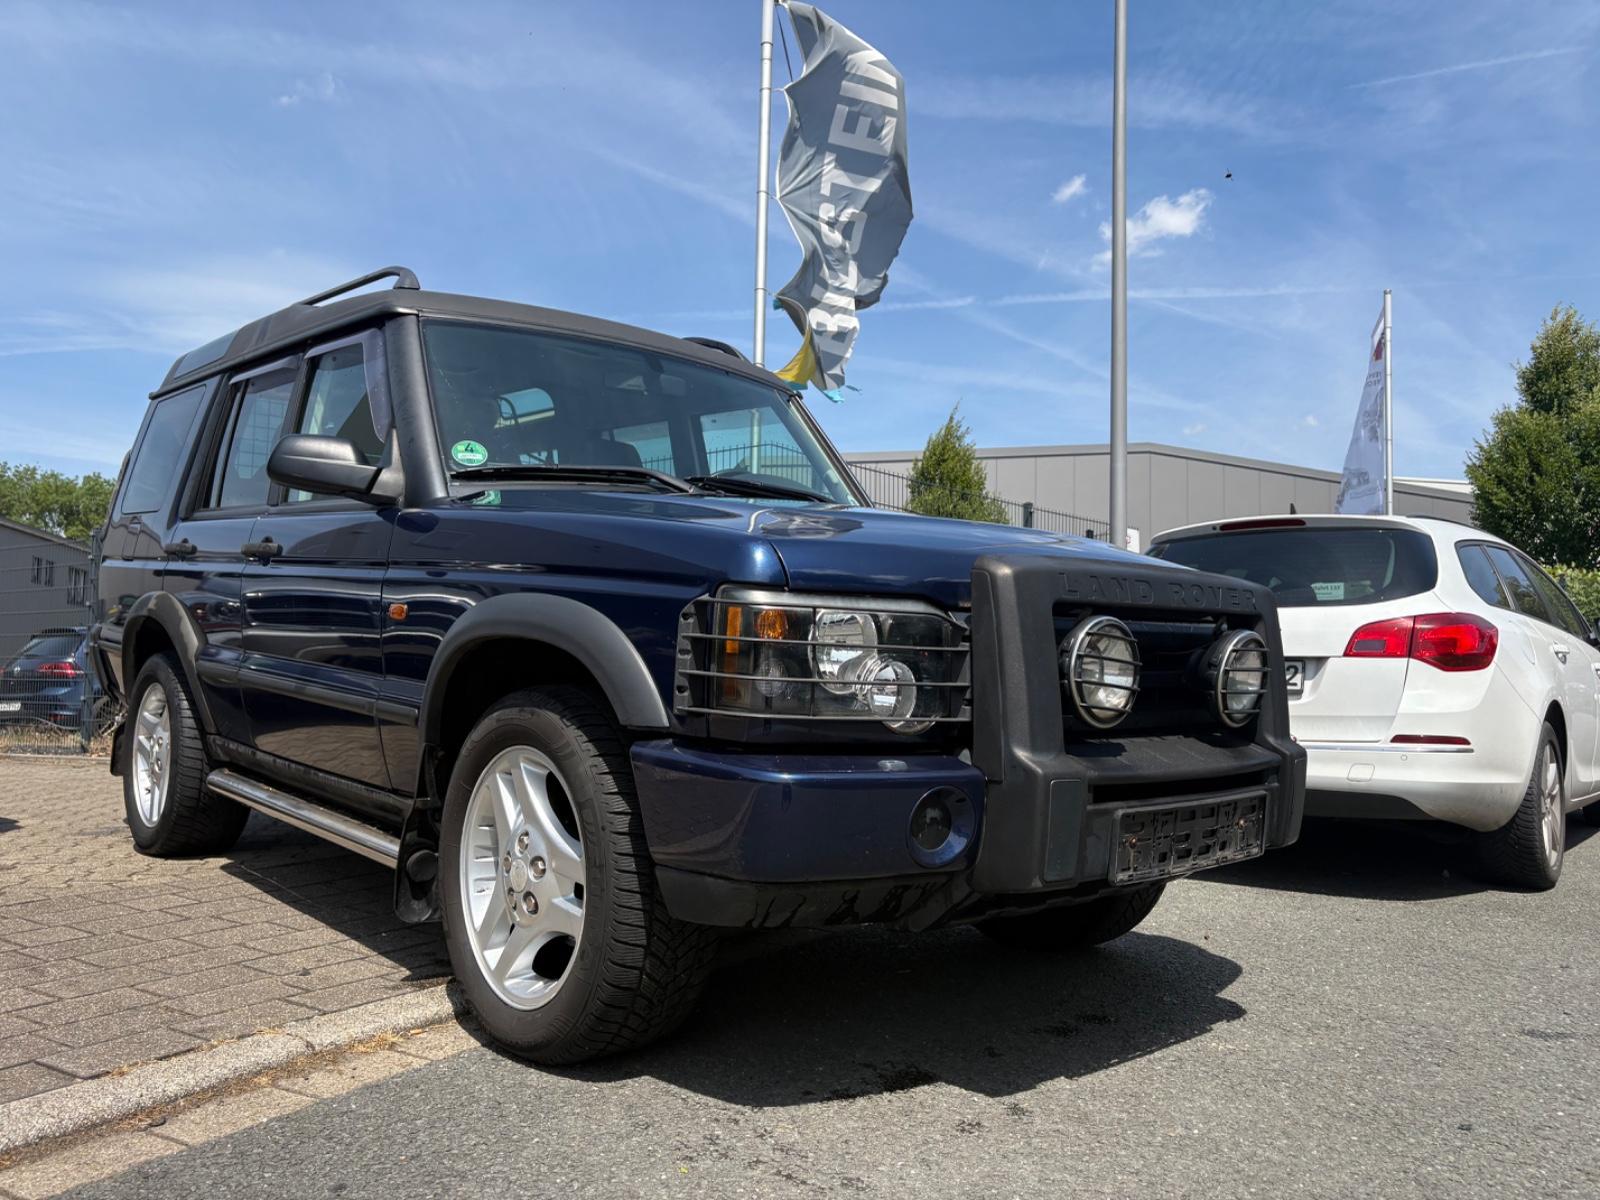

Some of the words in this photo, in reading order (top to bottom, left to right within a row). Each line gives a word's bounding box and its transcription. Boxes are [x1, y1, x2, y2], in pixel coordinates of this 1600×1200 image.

[464, 442, 474, 453] 4
[1058, 572, 1153, 604] LAND
[1167, 582, 1257, 611] ROVER
